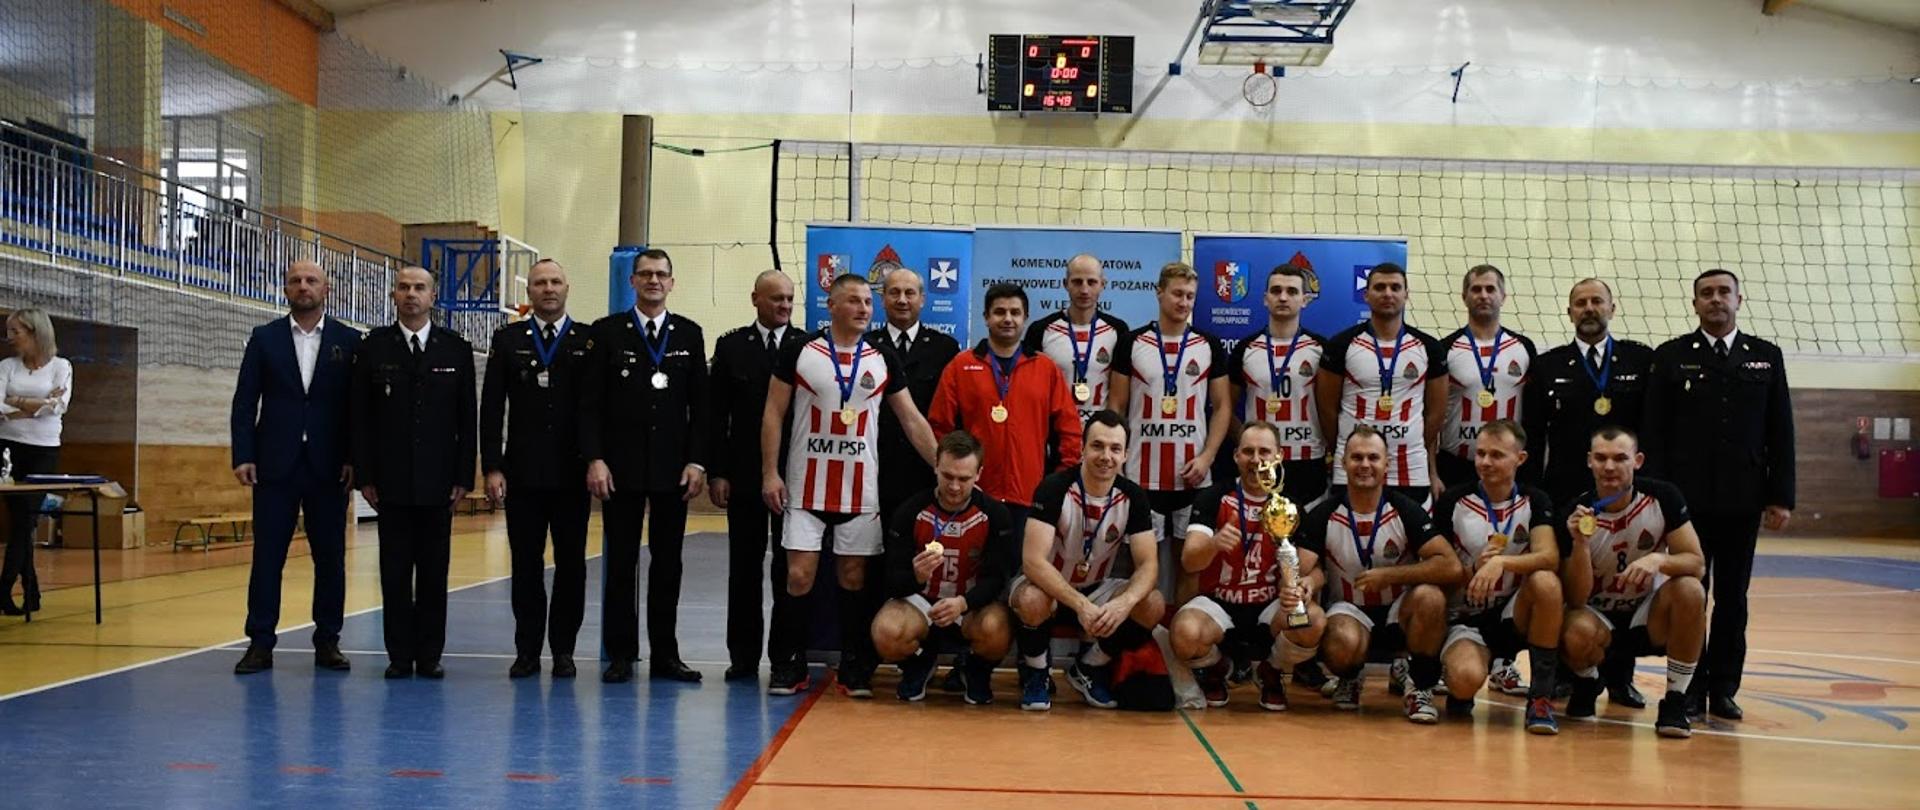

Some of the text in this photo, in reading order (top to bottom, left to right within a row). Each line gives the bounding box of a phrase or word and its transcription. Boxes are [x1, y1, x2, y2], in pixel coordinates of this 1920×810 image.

[1011, 258, 1142, 270] KOMENDA ATOWA
[1111, 279, 1159, 291] POŻARN
[1040, 300, 1051, 309] W
[1140, 423, 1197, 438] KM PSP
[1285, 426, 1312, 441] PSP
[1382, 425, 1409, 439] PSP
[807, 438, 867, 456] KM PSP
[942, 556, 959, 581] 15
[1616, 551, 1627, 572] 8
[1215, 586, 1276, 604] KM PSP
